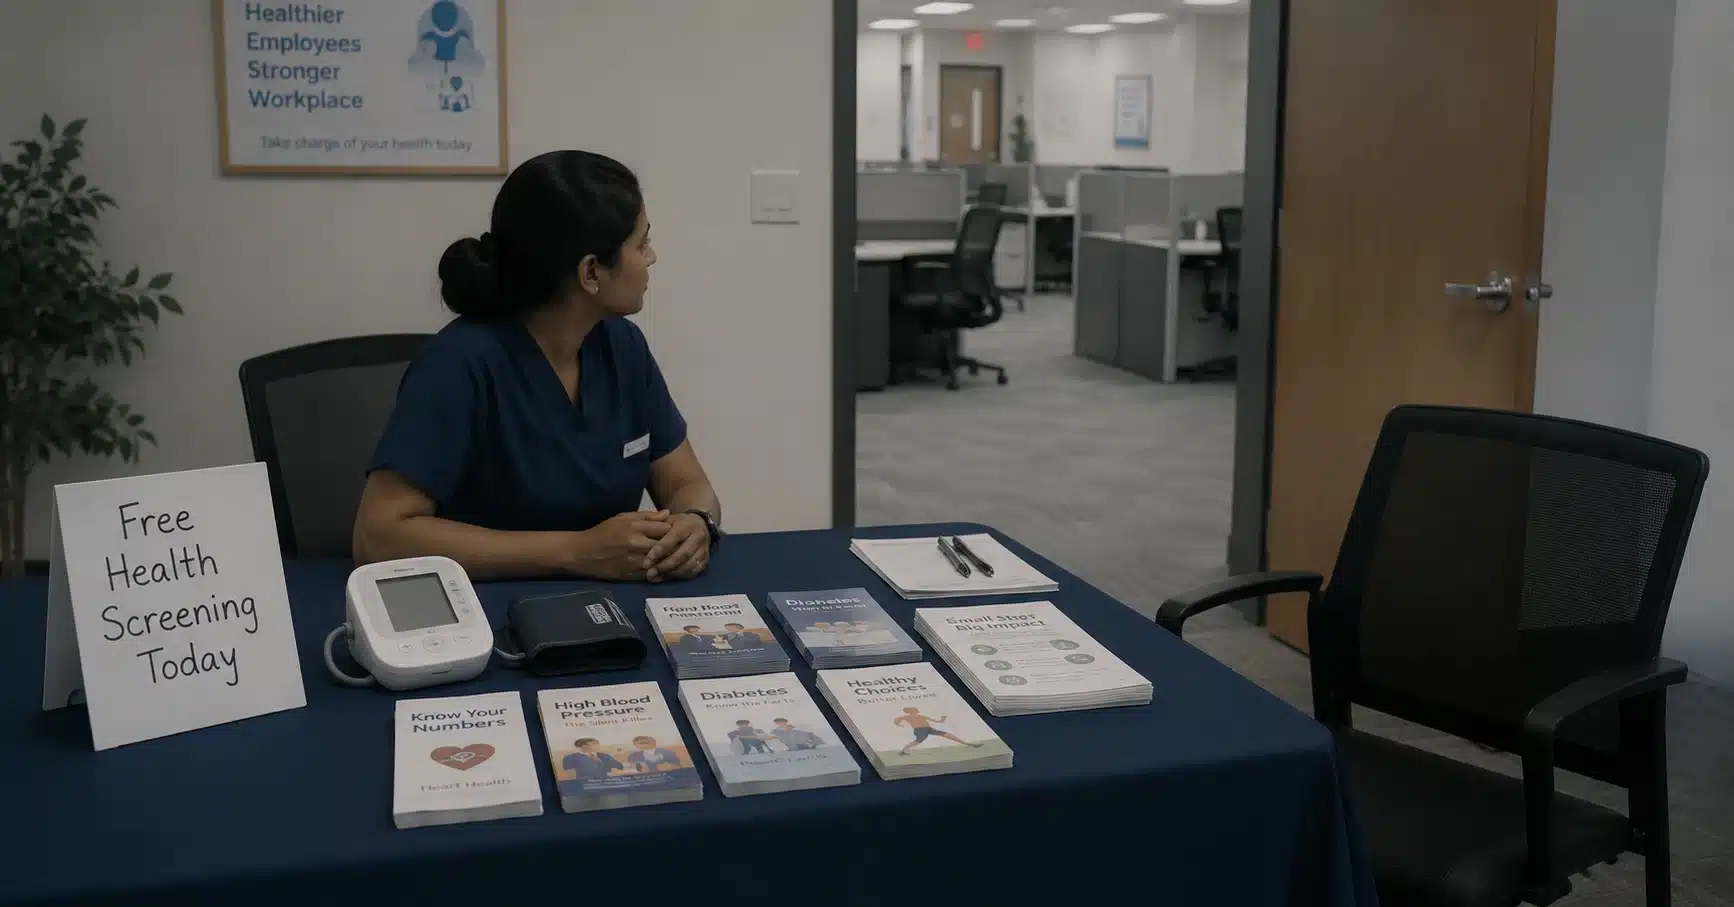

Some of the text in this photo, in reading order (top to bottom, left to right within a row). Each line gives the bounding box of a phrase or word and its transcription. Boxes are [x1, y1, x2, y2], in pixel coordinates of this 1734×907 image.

[245, 3, 344, 24] Healthier
[247, 32, 361, 55] Employees
[248, 60, 340, 83] Stronger
[248, 89, 363, 112] Workplace
[260, 136, 288, 149] Take
[295, 136, 340, 151] charge
[344, 136, 357, 149] of
[360, 138, 389, 151] your
[436, 138, 473, 152] today
[119, 501, 195, 540] Free
[105, 543, 219, 592] Health
[101, 594, 259, 642] Screening
[946, 615, 993, 625] Small
[987, 620, 1047, 630] Impact
[136, 642, 239, 687] Today
[847, 676, 917, 688] Healthy
[854, 684, 927, 696] Choices
[699, 687, 788, 701] Diabetes
[554, 695, 651, 711] High Blood
[411, 707, 507, 722] Know Your
[561, 706, 644, 719] Pressure
[413, 718, 507, 733] Numbers
